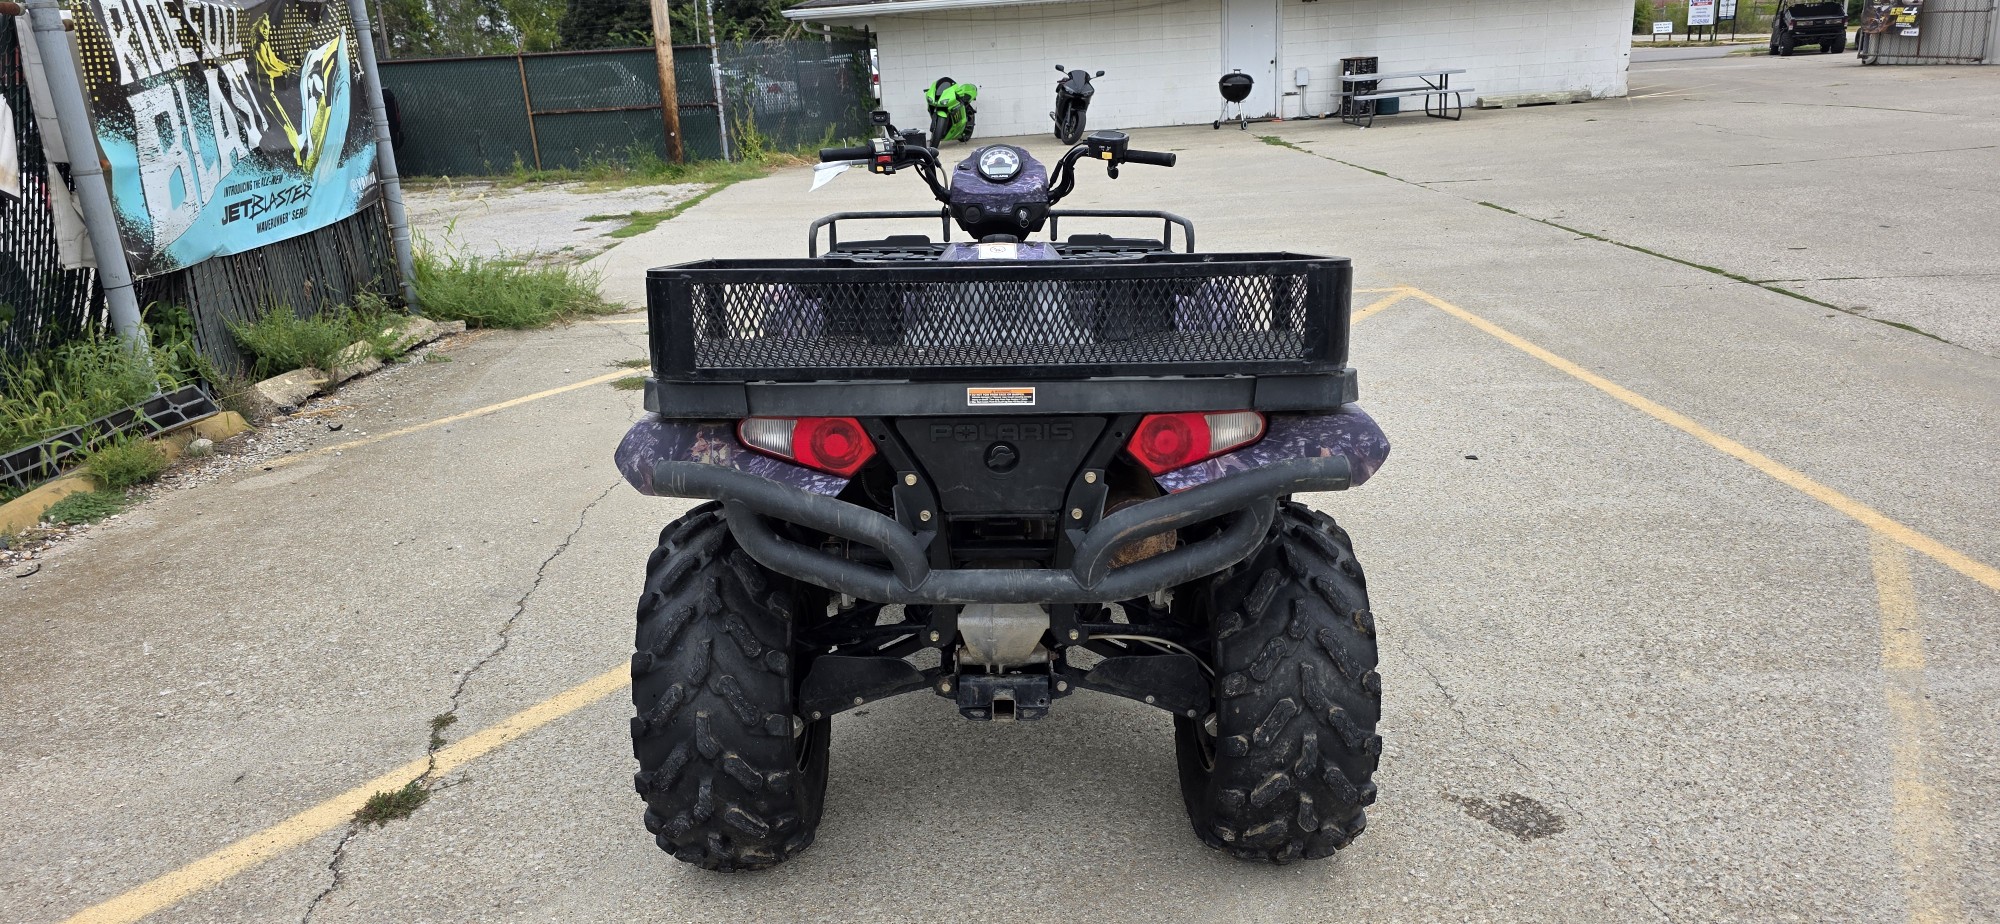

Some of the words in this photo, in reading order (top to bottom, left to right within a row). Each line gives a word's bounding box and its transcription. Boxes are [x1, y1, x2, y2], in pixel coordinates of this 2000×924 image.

[100, 0, 199, 85] RIDE
[127, 58, 269, 258] BLAST
[223, 180, 253, 198] INTRODUCING
[253, 179, 261, 190] THE
[261, 174, 284, 187] ALL-NEW
[291, 205, 309, 221] SERI
[929, 423, 1074, 442] POLARIS
